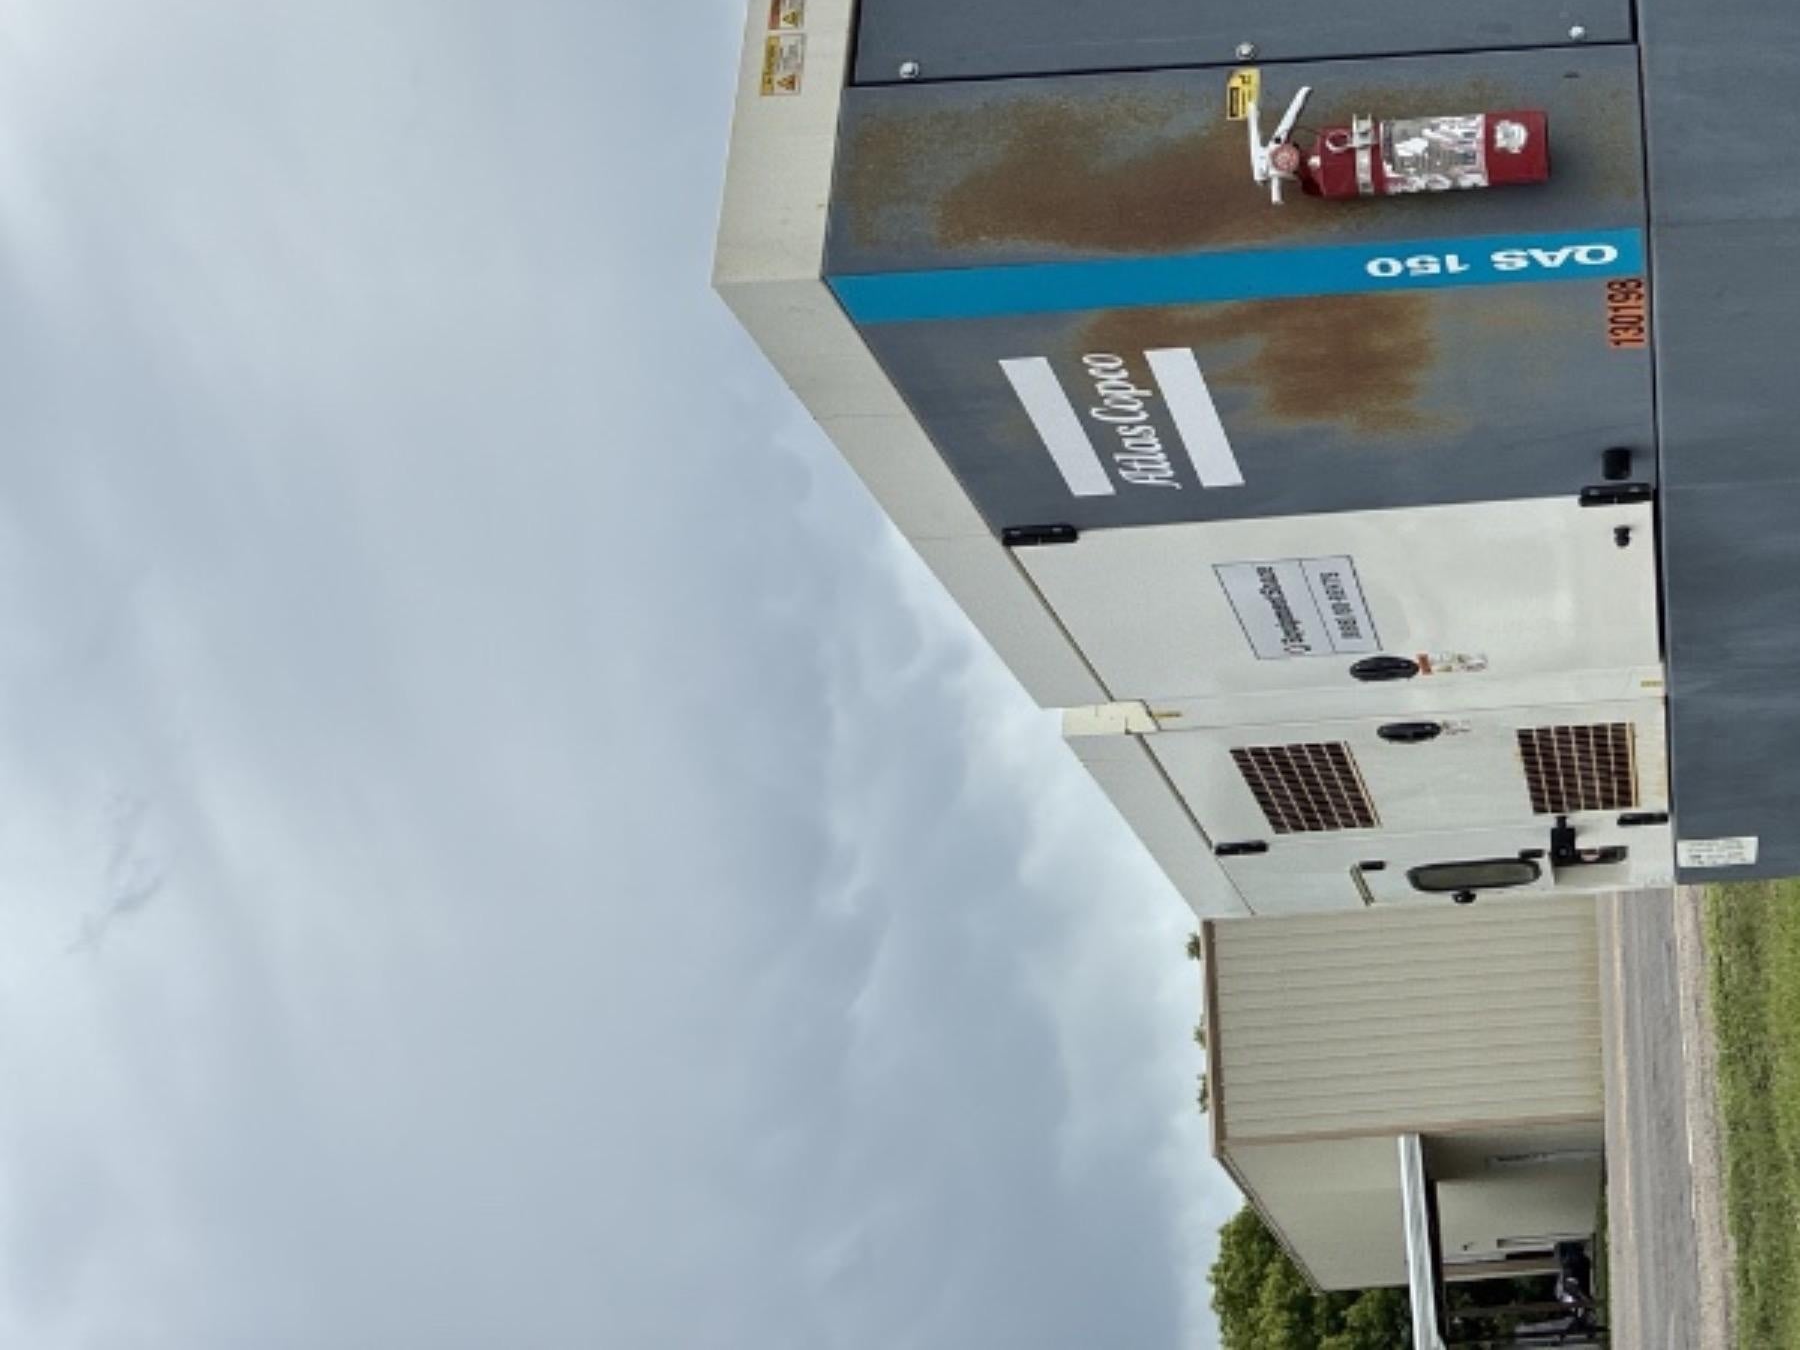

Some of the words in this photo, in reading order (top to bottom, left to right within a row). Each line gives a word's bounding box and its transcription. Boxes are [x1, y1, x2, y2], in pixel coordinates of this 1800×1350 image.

[1365, 254, 1470, 278] 150
[1490, 244, 1618, 271] QAS
[1606, 277, 1645, 347] 130198
[1082, 353, 1153, 423] Copco
[1112, 425, 1183, 490] Atlas
